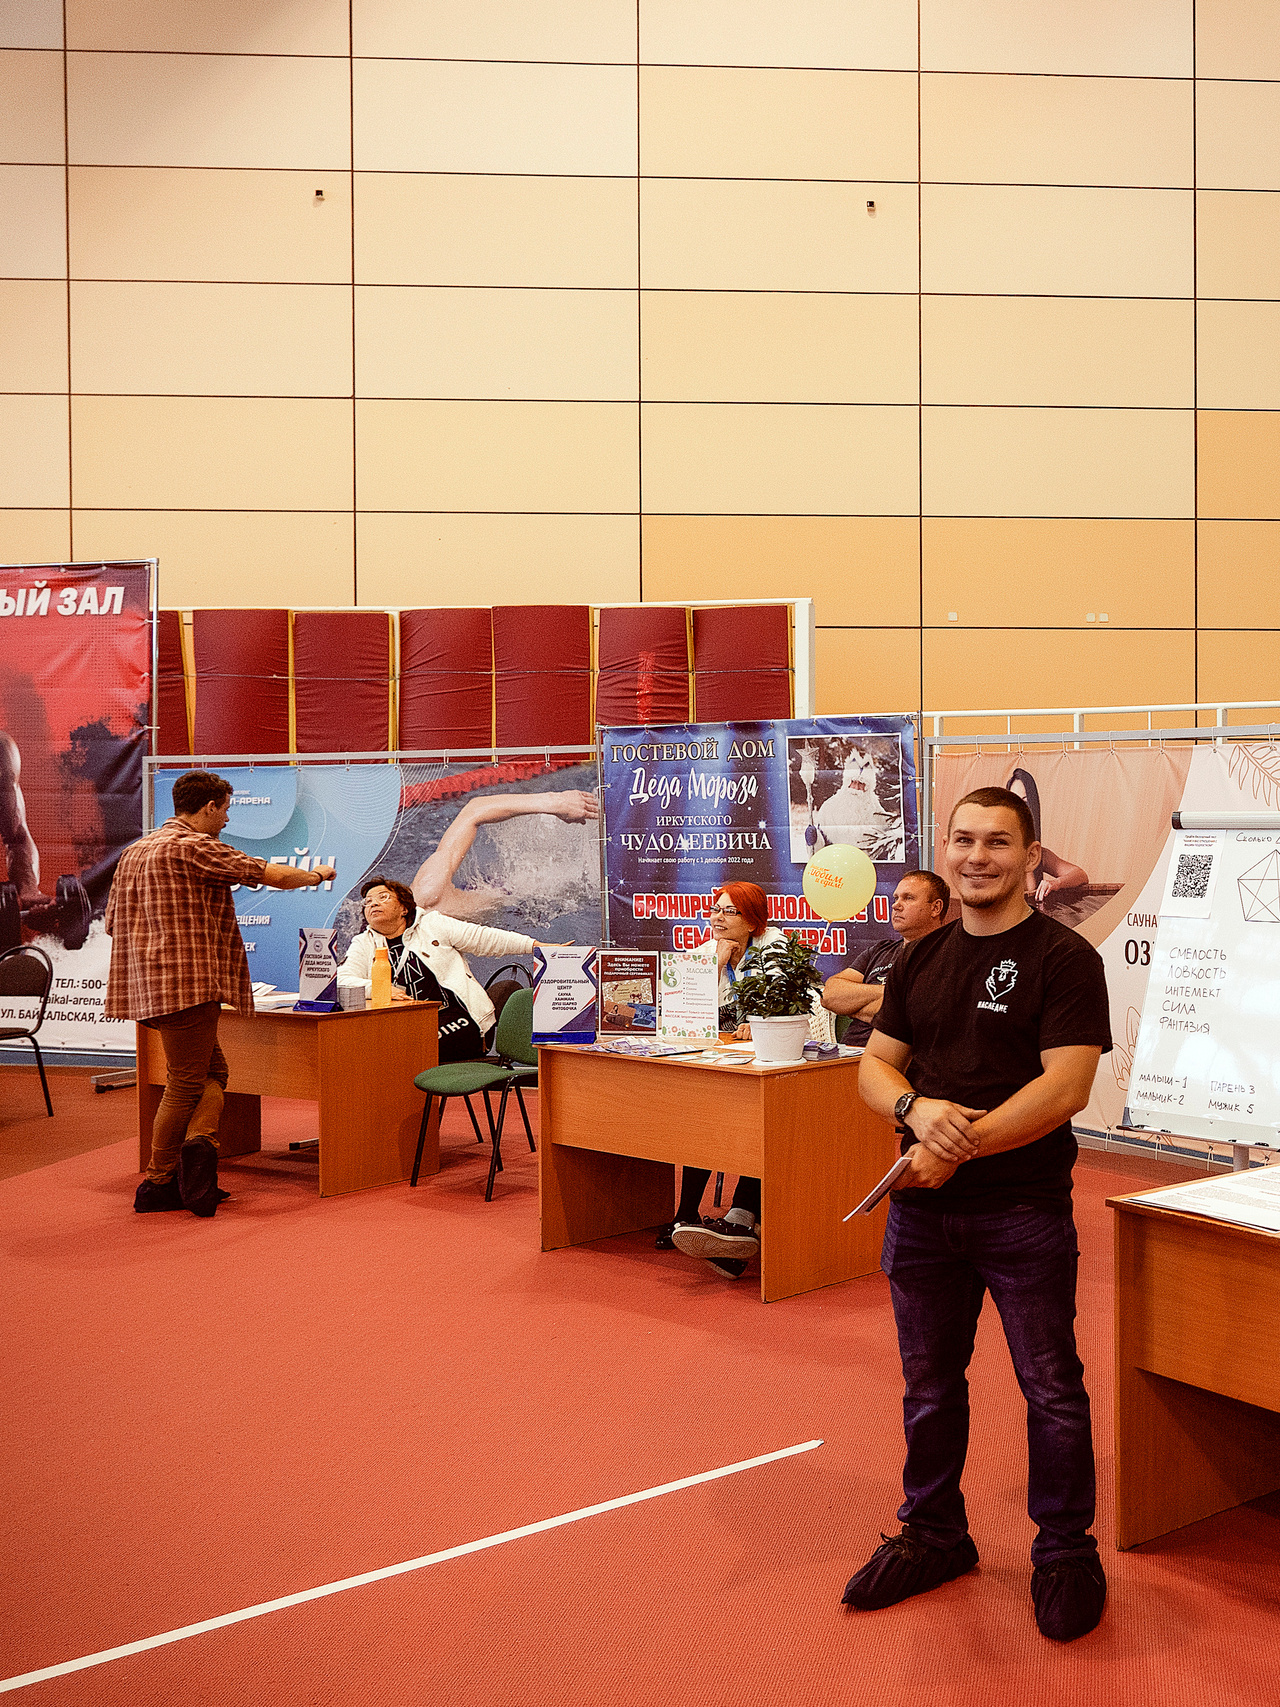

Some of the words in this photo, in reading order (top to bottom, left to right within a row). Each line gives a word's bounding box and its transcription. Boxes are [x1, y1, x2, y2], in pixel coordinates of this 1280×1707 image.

[56, 586, 125, 616] ЗАЛ
[611, 737, 719, 763] ГОСТЕВОЙ
[727, 739, 776, 762] ДОМ
[629, 767, 684, 810] Деда
[687, 767, 760, 809] Мороза
[655, 815, 733, 828] ИРКУТСКОГО
[620, 833, 773, 854] ЧУДОДЕЕВИЧА
[1235, 832, 1273, 843] Сколько
[678, 857, 695, 866] работу
[633, 887, 722, 920] БРОНИРУ
[873, 895, 891, 924] И
[1127, 912, 1158, 928] САУНА
[672, 924, 714, 951] СЕМ
[1124, 940, 1151, 967] ОЗ
[1169, 947, 1227, 961] СМЕЛОСТЬ
[1167, 965, 1227, 980] ЛОВКОСТЬ
[55, 978, 80, 989] ТЕЛ.:
[81, 980, 107, 989] 500-
[1, 1009, 16, 1019] УЛ.
[1162, 999, 1196, 1015] СИЛА
[1160, 1016, 1210, 1035] ФАНТАЗИЯ
[1249, 1085, 1256, 1095] 3
[1247, 1104, 1255, 1114] 5
